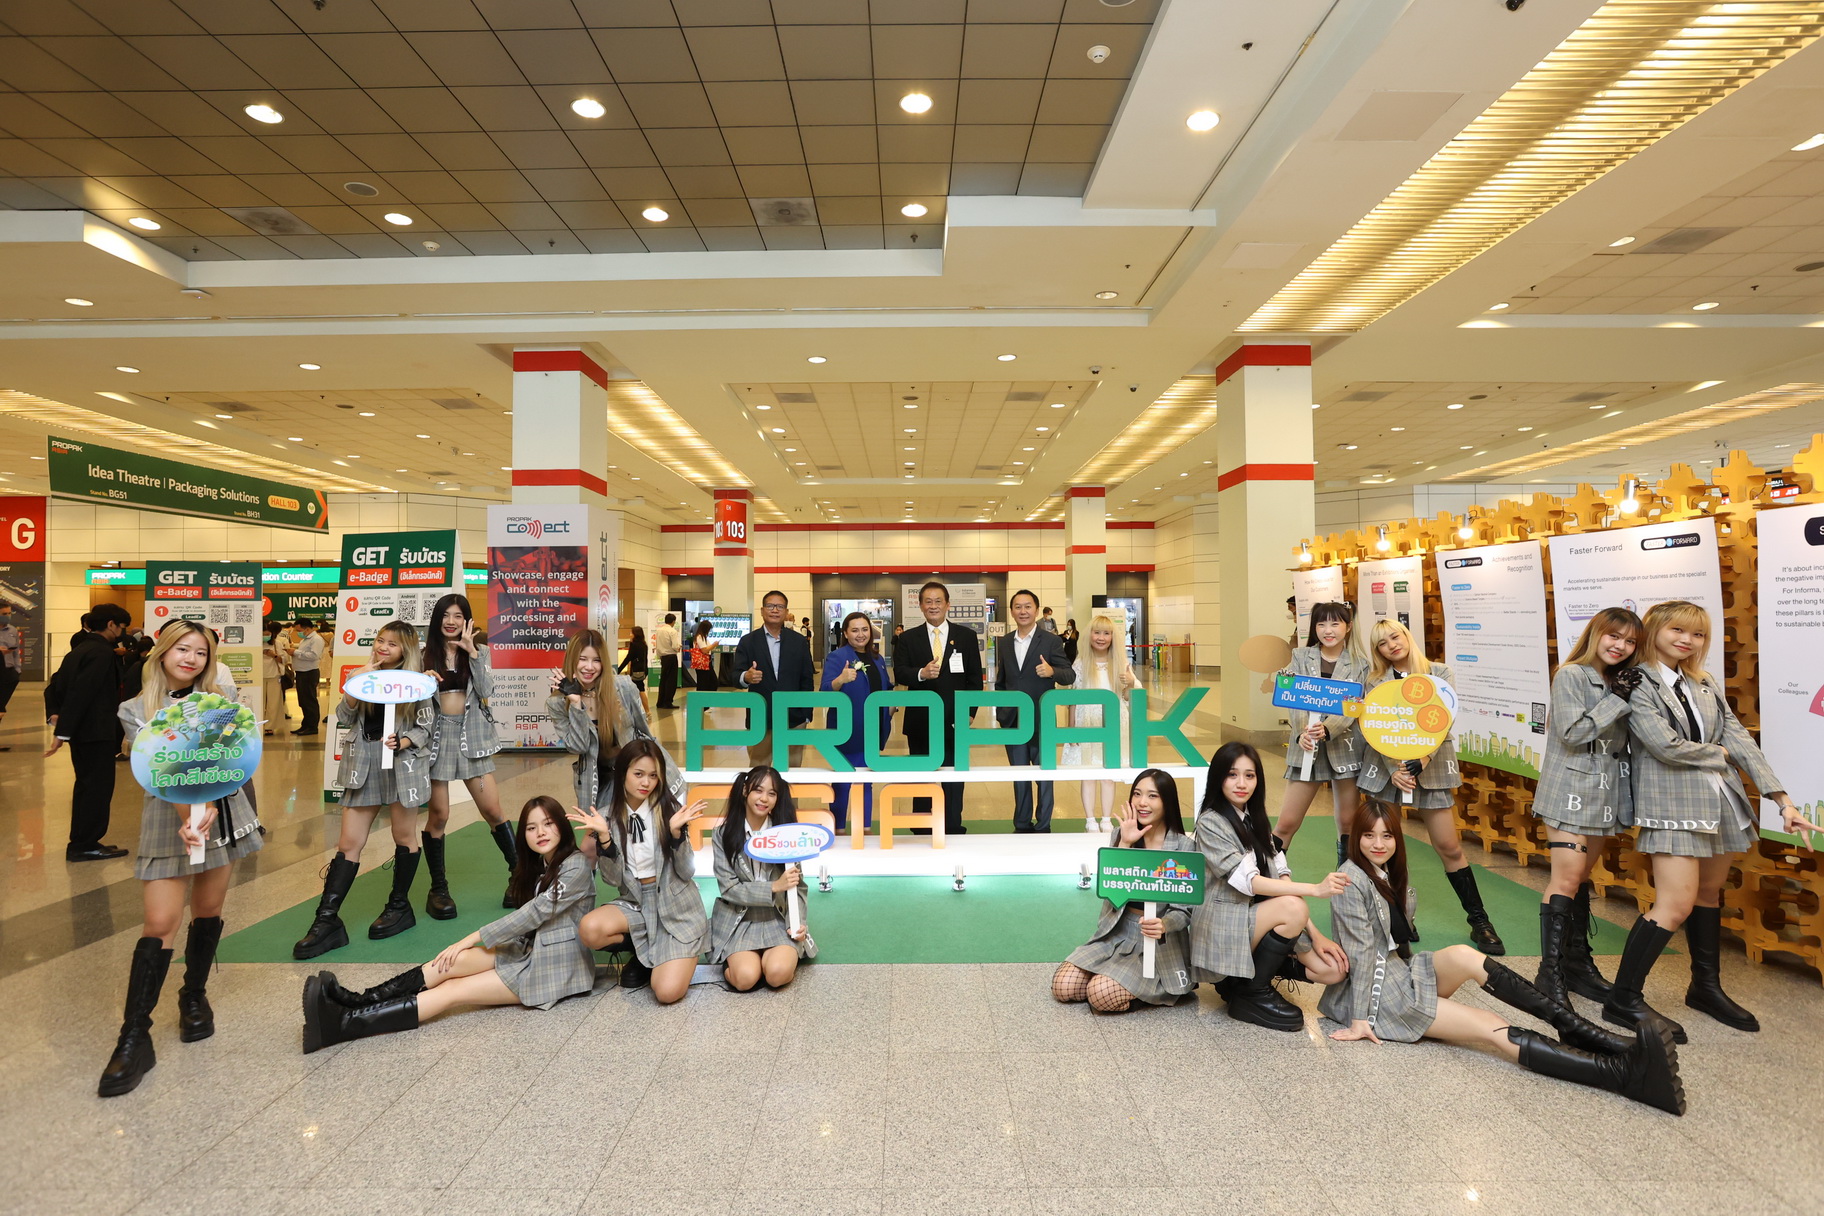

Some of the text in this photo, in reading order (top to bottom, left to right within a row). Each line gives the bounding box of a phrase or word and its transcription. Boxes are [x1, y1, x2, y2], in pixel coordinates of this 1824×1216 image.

[51, 440, 83, 452] PROPAK
[88, 464, 260, 505] Idea Theatre Packaging Solutions
[109, 489, 128, 500] BG51
[270, 497, 298, 509] HALL 103
[11, 517, 36, 550] G
[726, 520, 745, 539] 103
[1594, 544, 1623, 552] Forward
[352, 546, 390, 566] GET
[400, 546, 446, 564] รับบัตร
[1492, 554, 1523, 562] Achievements
[1507, 564, 1534, 572] Recognition
[158, 570, 198, 584] GET
[209, 572, 254, 586] รับบัตร
[282, 572, 314, 581] Counter
[350, 572, 389, 584] e-Badge
[492, 571, 545, 580] Showcase,
[548, 572, 584, 581] engage
[1786, 576, 1814, 584] negative
[156, 588, 199, 598] e-Badge
[506, 585, 570, 594] and connect
[1794, 587, 1822, 595] Informa,
[349, 600, 354, 610] 1
[516, 598, 560, 608] with the
[1804, 598, 1818, 606] long
[500, 612, 576, 624] processing and
[1795, 610, 1814, 618] pillars
[346, 630, 352, 642] 2
[512, 628, 564, 638] packaging
[493, 642, 552, 652] community
[1295, 680, 1322, 692] เปลี่ยน
[1778, 688, 1809, 696] Colleagues
[1281, 691, 1296, 702] เป็น
[1366, 702, 1414, 716] เข้าวงจร
[684, 687, 1211, 773] PROPAK
[1364, 718, 1416, 732] เศรษฐกิจ
[1380, 734, 1436, 748] หมุนเวียน
[1598, 738, 1613, 756] Y
[154, 742, 244, 764] ร่วมสร้าง
[402, 758, 416, 774] Y
[1366, 764, 1380, 779] B
[1446, 760, 1458, 775] R
[150, 766, 246, 788] โลกสีเขียว
[1598, 772, 1610, 790] R
[1565, 794, 1583, 812] B
[1602, 806, 1614, 822] B
[1103, 866, 1148, 877] พลาสติก
[1102, 879, 1194, 894] บรรจุภัณฑ์ใช้แล้ว
[1175, 970, 1189, 988] B
